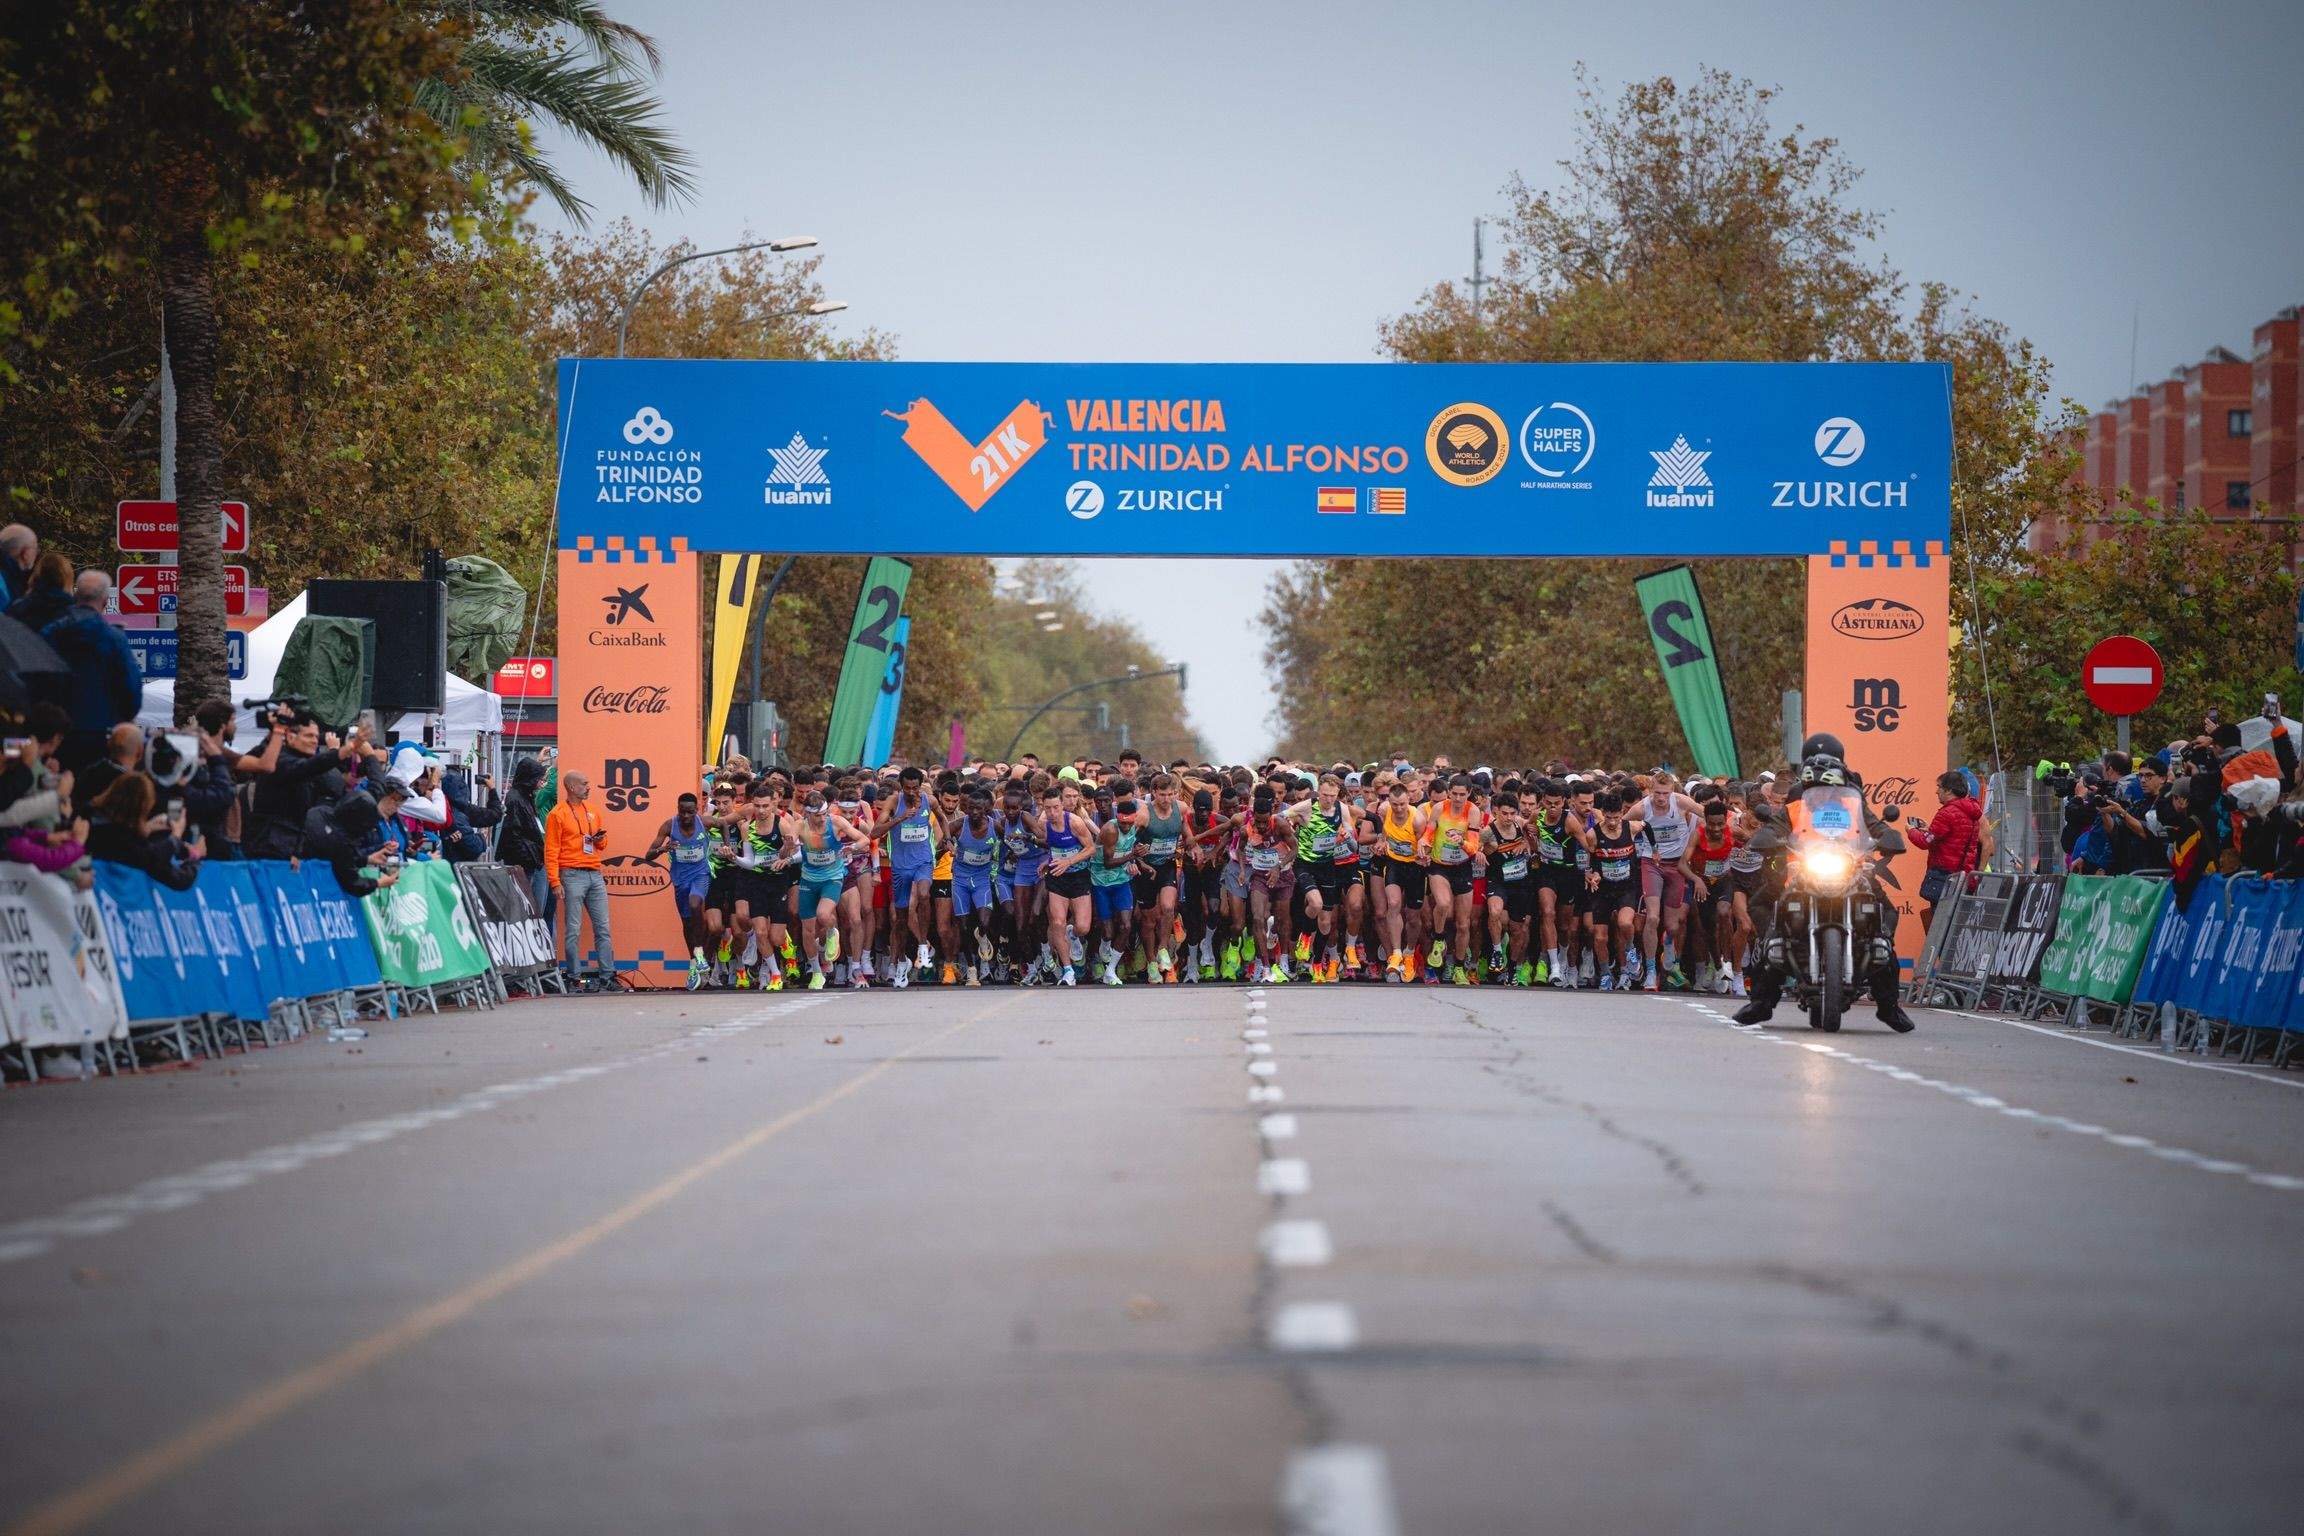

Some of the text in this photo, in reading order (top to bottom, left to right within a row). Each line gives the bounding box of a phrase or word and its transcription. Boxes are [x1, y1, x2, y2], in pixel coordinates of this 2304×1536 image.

[1066, 399, 1226, 432] VALENCIA
[1430, 406, 1462, 438] GOLD LABEL
[1534, 428, 1582, 440] SUPER
[597, 449, 701, 462] FUNDACIÓN
[1533, 441, 1582, 453] HALFS
[970, 421, 1032, 492] 21K
[1067, 443, 1409, 474] TRINIDAD ALFONSO
[596, 465, 702, 484] TRINIDAD
[596, 486, 702, 504] ALFONSO
[1571, 482, 1593, 490] SERIES
[1771, 481, 1908, 507] ZURICH
[764, 487, 832, 505] luanvi
[1117, 490, 1223, 511] ZURICH
[1646, 490, 1714, 507] luanvi
[125, 520, 156, 532] Otros
[157, 584, 171, 593] en
[852, 585, 900, 654] 2
[1839, 613, 1917, 630] ASTURIANA
[127, 637, 147, 646] unto
[148, 636, 160, 646] de
[588, 631, 667, 647] CaixaBank
[881, 642, 905, 694] 3
[583, 685, 671, 714] Coca-Cola
[603, 875, 666, 886] STURIANA
